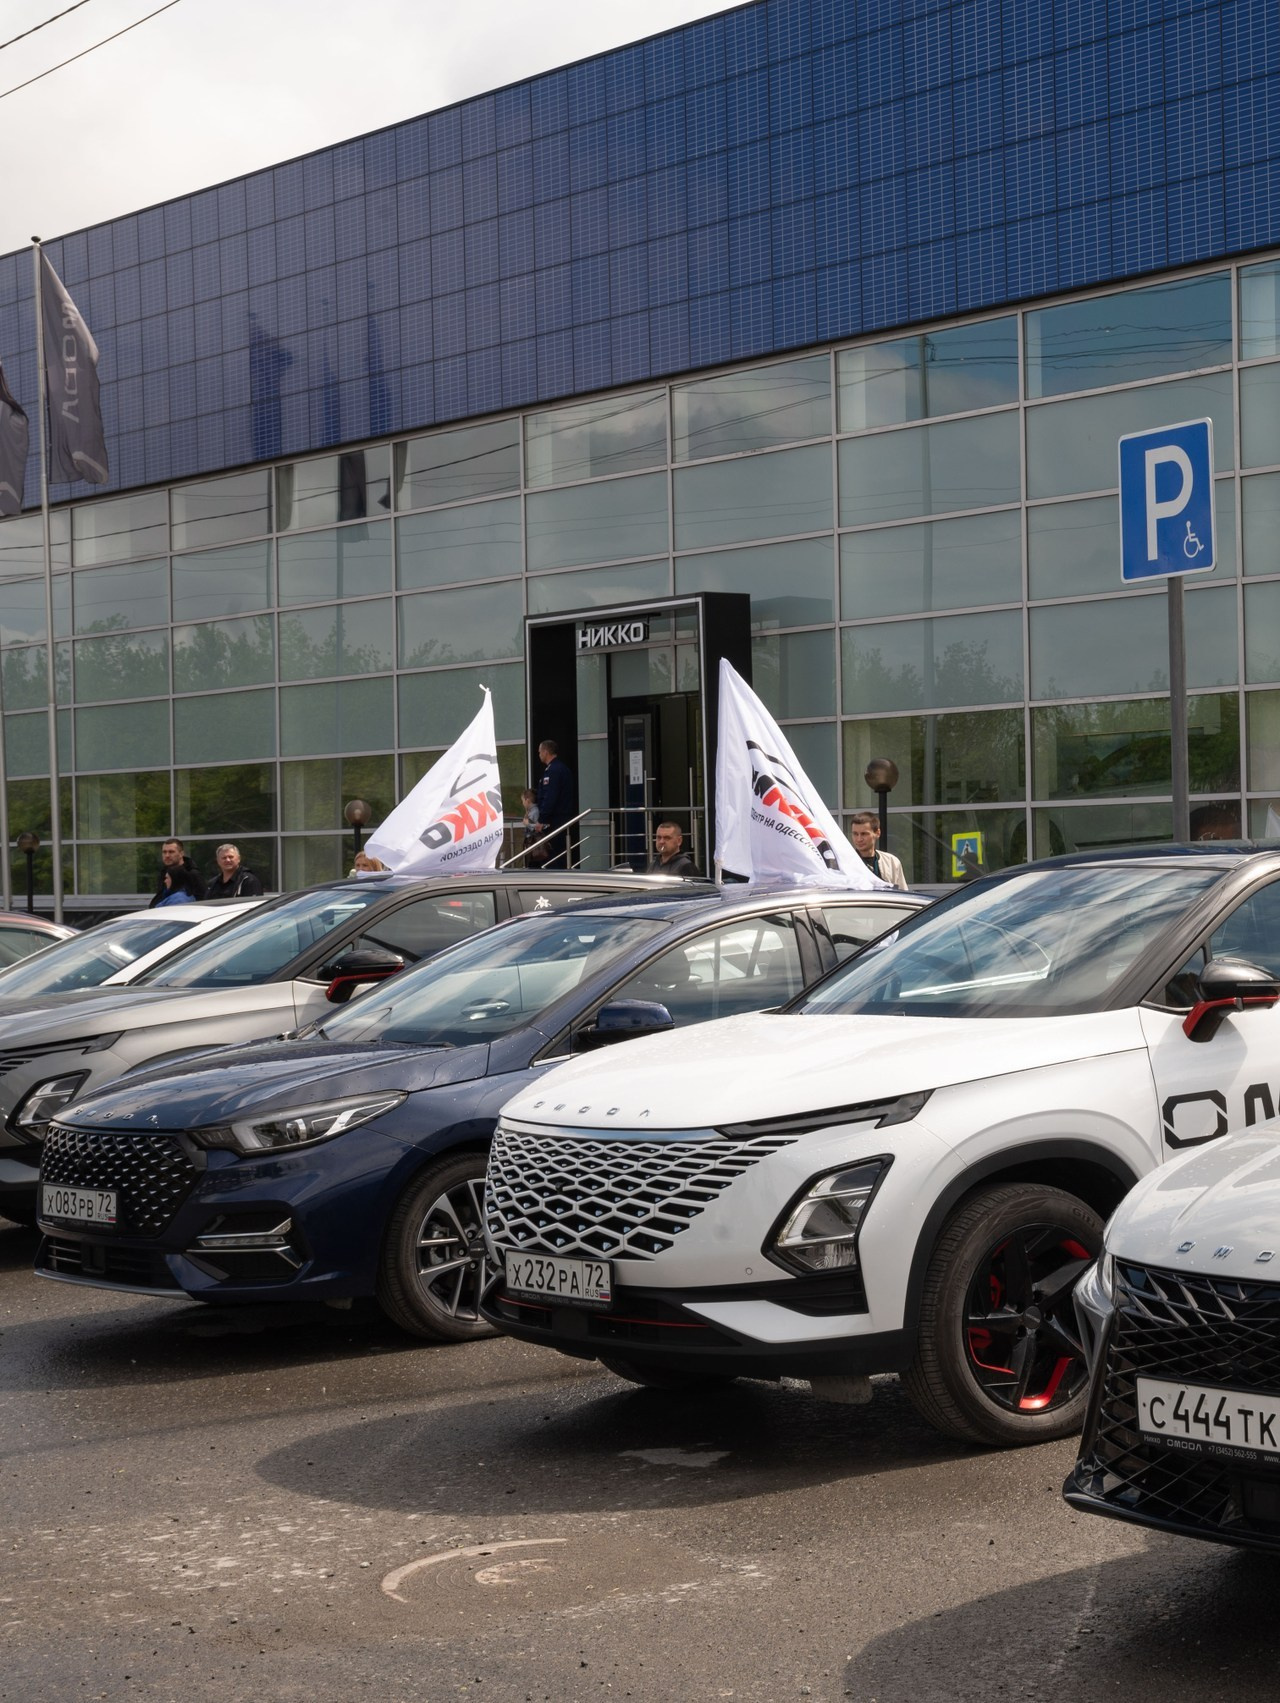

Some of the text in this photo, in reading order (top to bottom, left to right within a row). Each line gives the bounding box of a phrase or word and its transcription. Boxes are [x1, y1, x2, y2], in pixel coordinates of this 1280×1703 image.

[1145, 445, 1194, 561] P
[578, 622, 644, 649] НИККО
[98, 1193, 112, 1213] 72
[585, 1263, 604, 1288] 72
[585, 1288, 599, 1298] RUS
[1166, 1438, 1203, 1451] OMODA
[1207, 1445, 1216, 1454] +7
[1215, 1445, 1234, 1457] (3452)
[1233, 1448, 1258, 1460] 562-555
